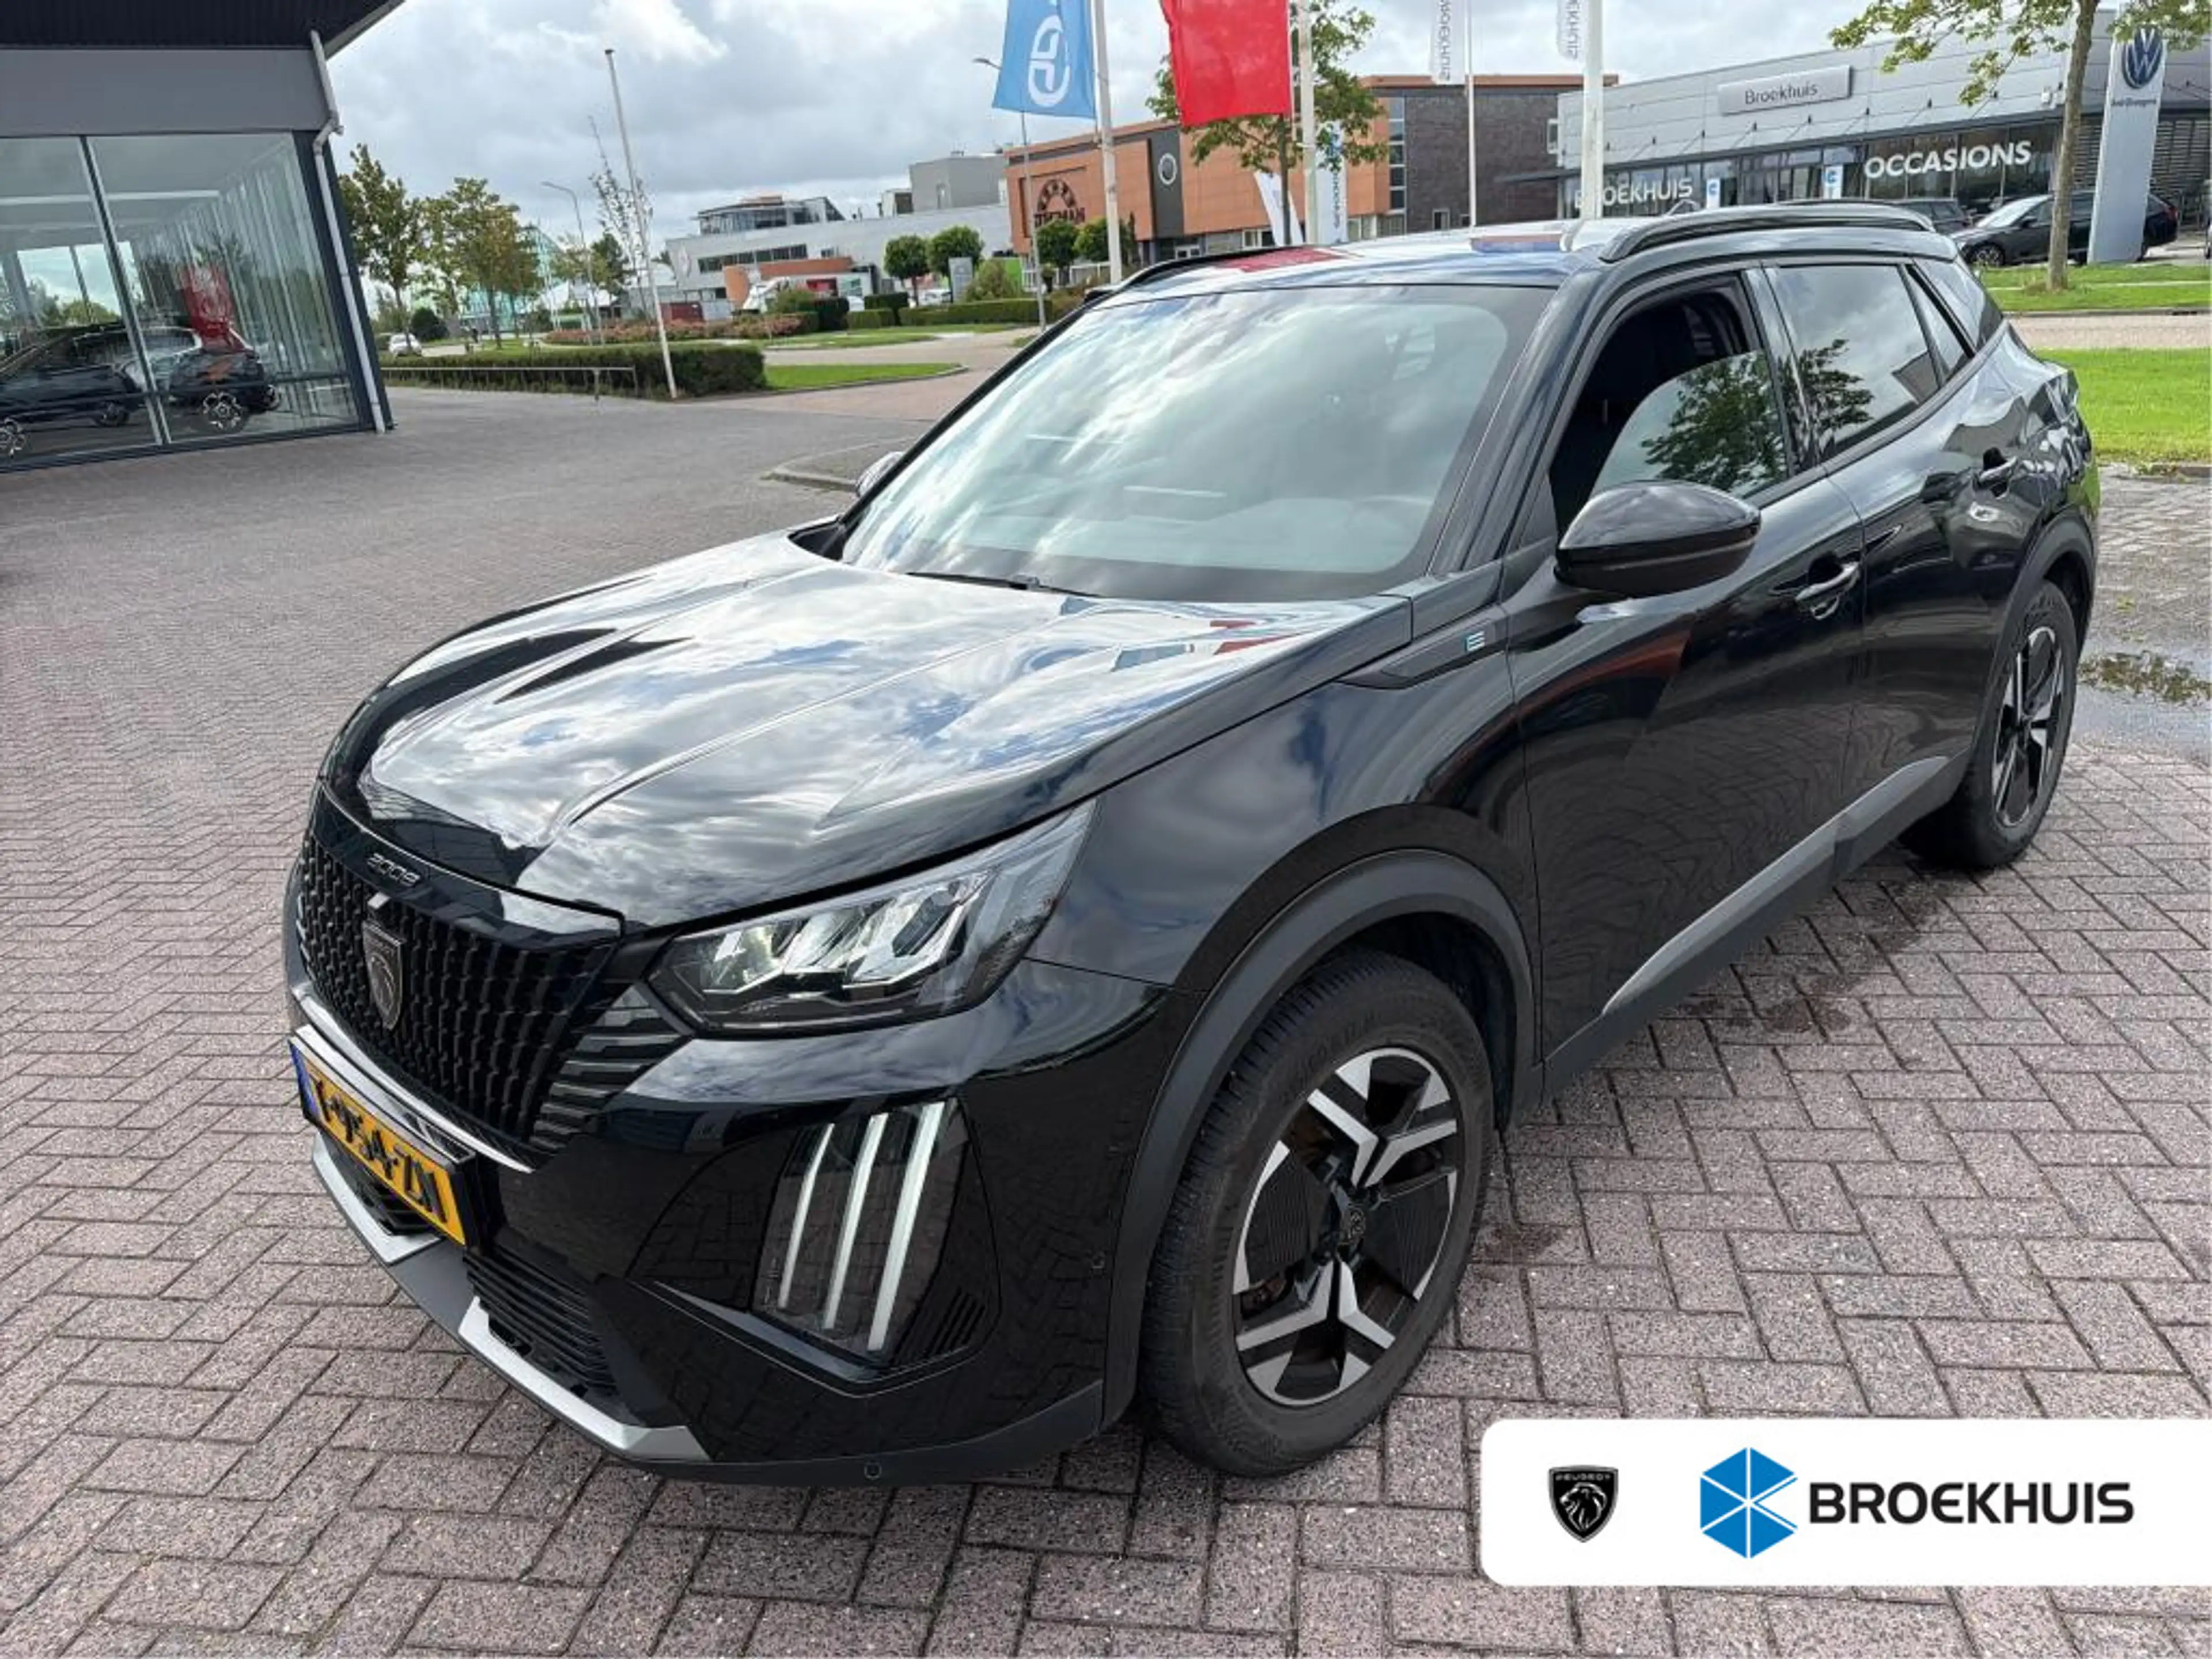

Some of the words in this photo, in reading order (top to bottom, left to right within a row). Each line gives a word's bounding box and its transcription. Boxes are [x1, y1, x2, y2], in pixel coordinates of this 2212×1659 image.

[1745, 81, 1818, 105] Broekhuis
[1865, 141, 2031, 179] OCCASIONS
[1574, 177, 1692, 209] BOEKHUIS
[367, 853, 421, 887] 2008
